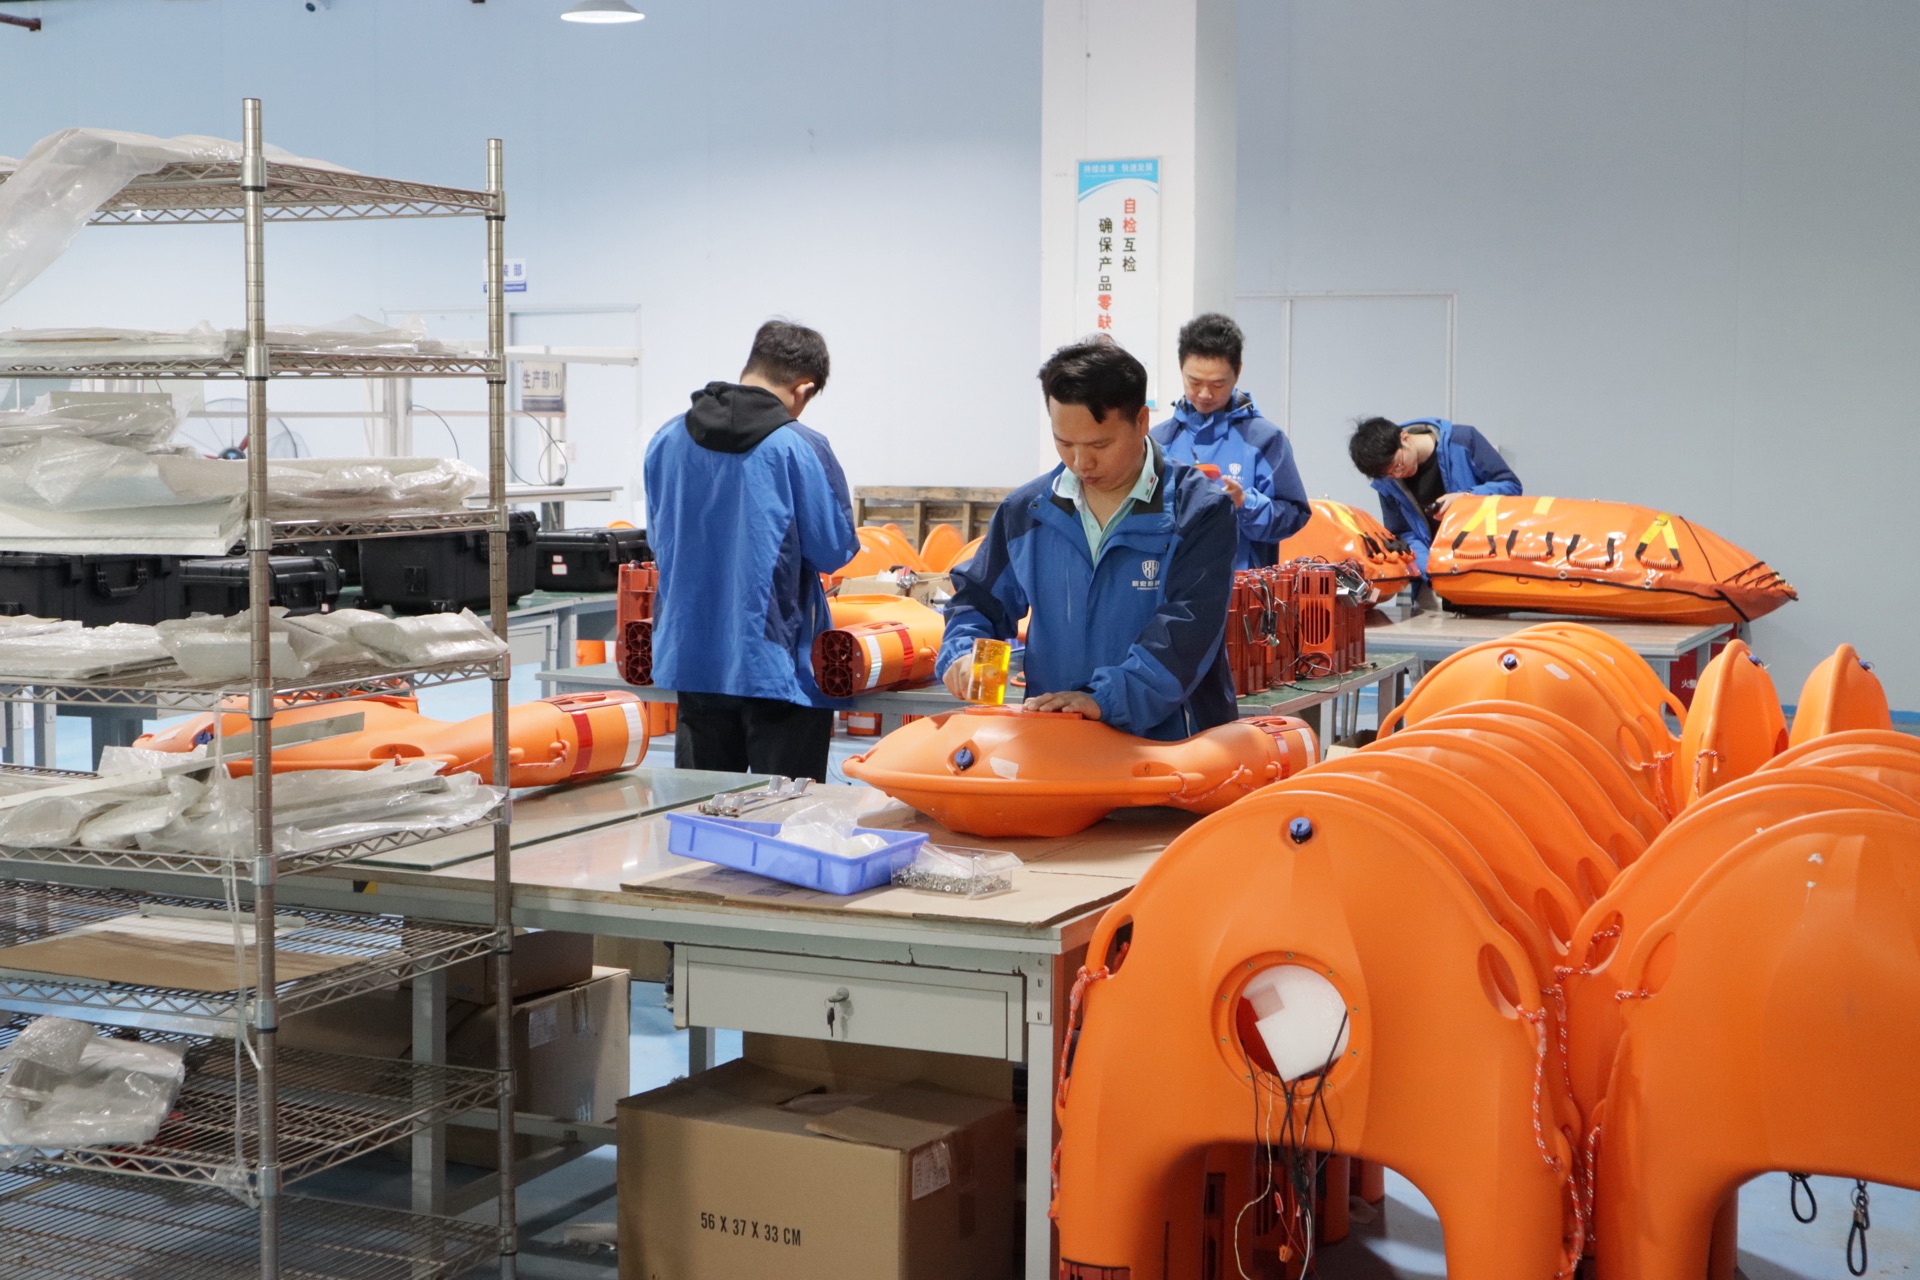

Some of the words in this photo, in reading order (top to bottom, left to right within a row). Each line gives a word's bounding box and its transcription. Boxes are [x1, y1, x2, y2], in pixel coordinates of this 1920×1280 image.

[1122, 198, 1136, 272] 自检互检
[1098, 218, 1112, 330] 确保产品零缺
[522, 369, 562, 390] 生产部(1)
[701, 1212, 715, 1230] 56
[720, 1215, 728, 1233] X
[733, 1219, 747, 1236] 37
[751, 1221, 759, 1239] X
[764, 1224, 779, 1243] 33
[783, 1227, 801, 1246] CM
